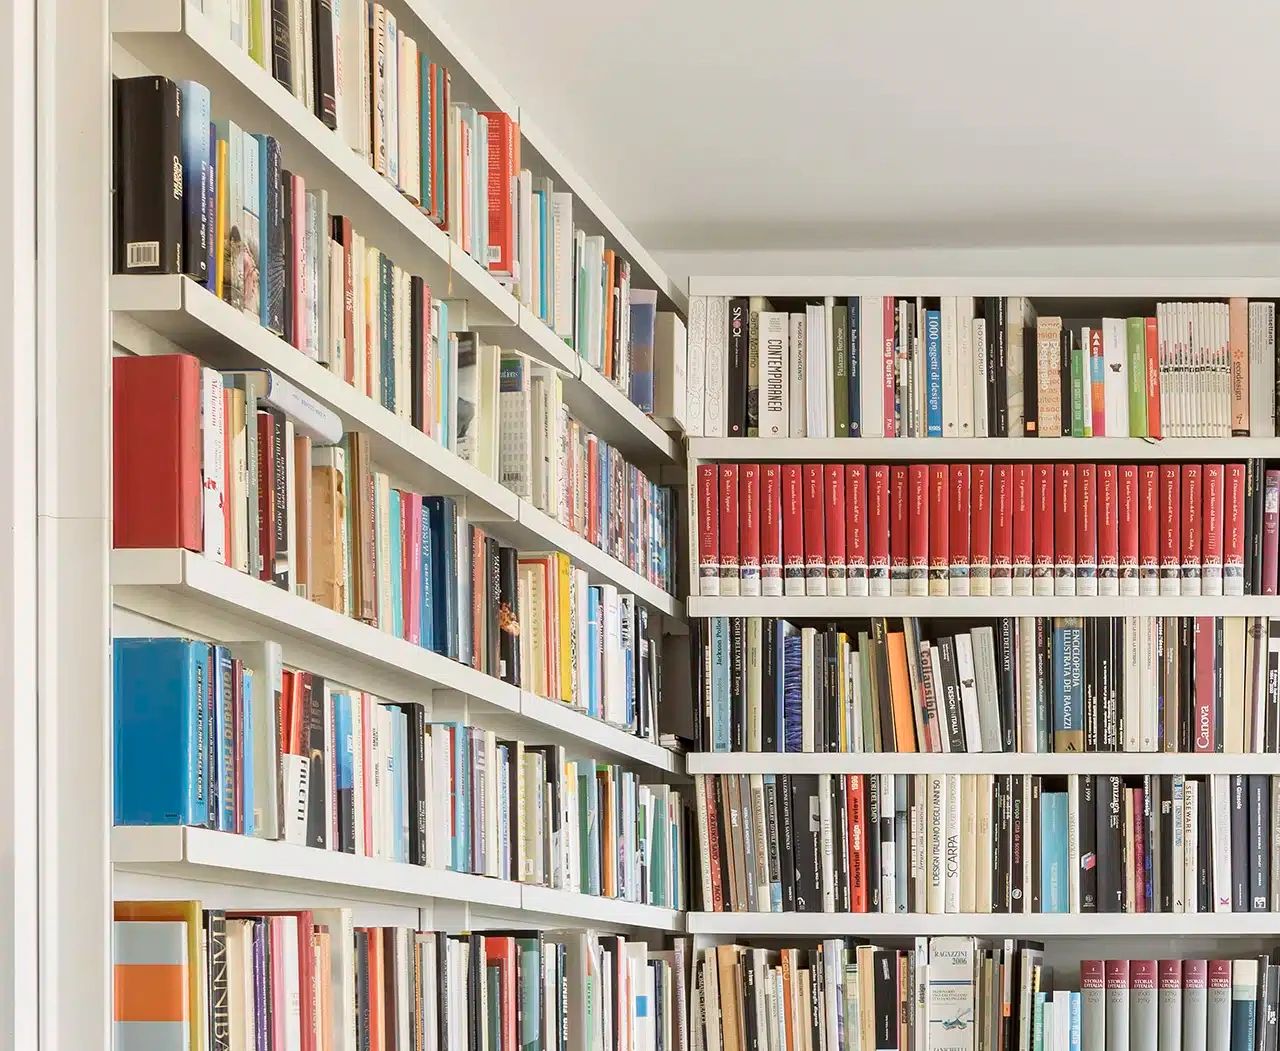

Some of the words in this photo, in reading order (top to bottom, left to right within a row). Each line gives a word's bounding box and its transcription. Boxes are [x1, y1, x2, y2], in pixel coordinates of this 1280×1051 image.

[929, 316, 939, 340] 1000
[885, 338, 894, 353] Tony
[929, 342, 939, 370] oggetti
[977, 325, 985, 376] NOVOCOMUM
[768, 339, 783, 412] CONTEMPORANEA
[885, 355, 894, 388] Oursler
[931, 372, 940, 381] di
[1234, 362, 1245, 401] ecodesign
[929, 382, 940, 410] design
[767, 469, 774, 477] 18
[852, 469, 860, 477] 24
[1083, 469, 1090, 477] 15
[1167, 470, 1175, 478] 23
[1209, 469, 1217, 477] 26
[1232, 469, 1240, 477] 21
[1063, 629, 1071, 677] ILLUSTRATA
[1072, 629, 1080, 687] ENCICLOPEDIA
[1063, 679, 1071, 692] DEI
[1063, 695, 1071, 729] RAGAZZI
[1197, 705, 1209, 748] Canova
[224, 746, 233, 810] FALETTI
[298, 760, 308, 821] FALETTI
[851, 775, 859, 791] 1996
[1110, 776, 1120, 814] gonzaga
[709, 813, 717, 842] KAZUKO
[853, 825, 861, 851] design
[1015, 834, 1021, 842] da
[853, 851, 861, 888] industrial
[947, 835, 958, 878] SCARPA
